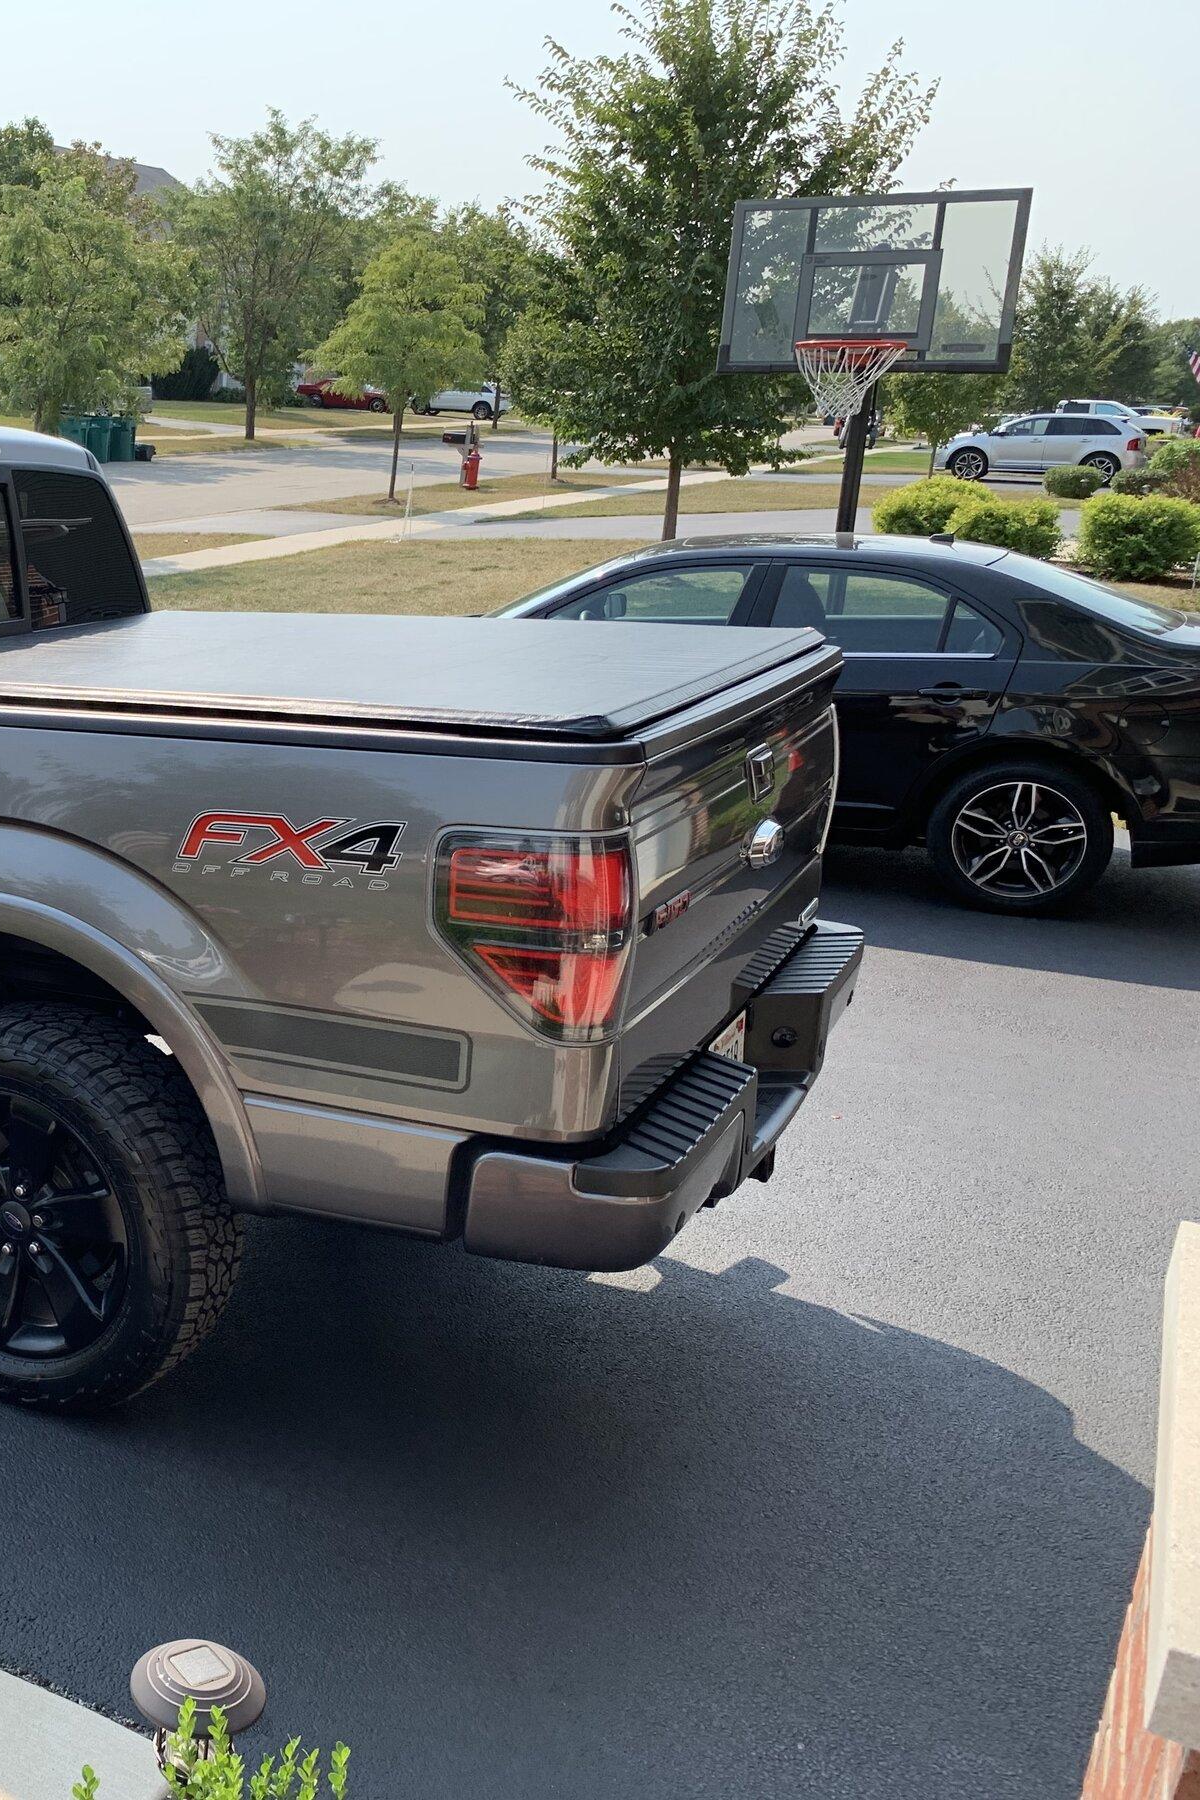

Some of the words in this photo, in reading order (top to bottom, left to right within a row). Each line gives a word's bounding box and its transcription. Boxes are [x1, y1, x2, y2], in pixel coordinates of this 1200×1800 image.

[176, 809, 408, 877] FX4
[172, 862, 251, 878] OFF
[269, 871, 390, 891] ROAD
